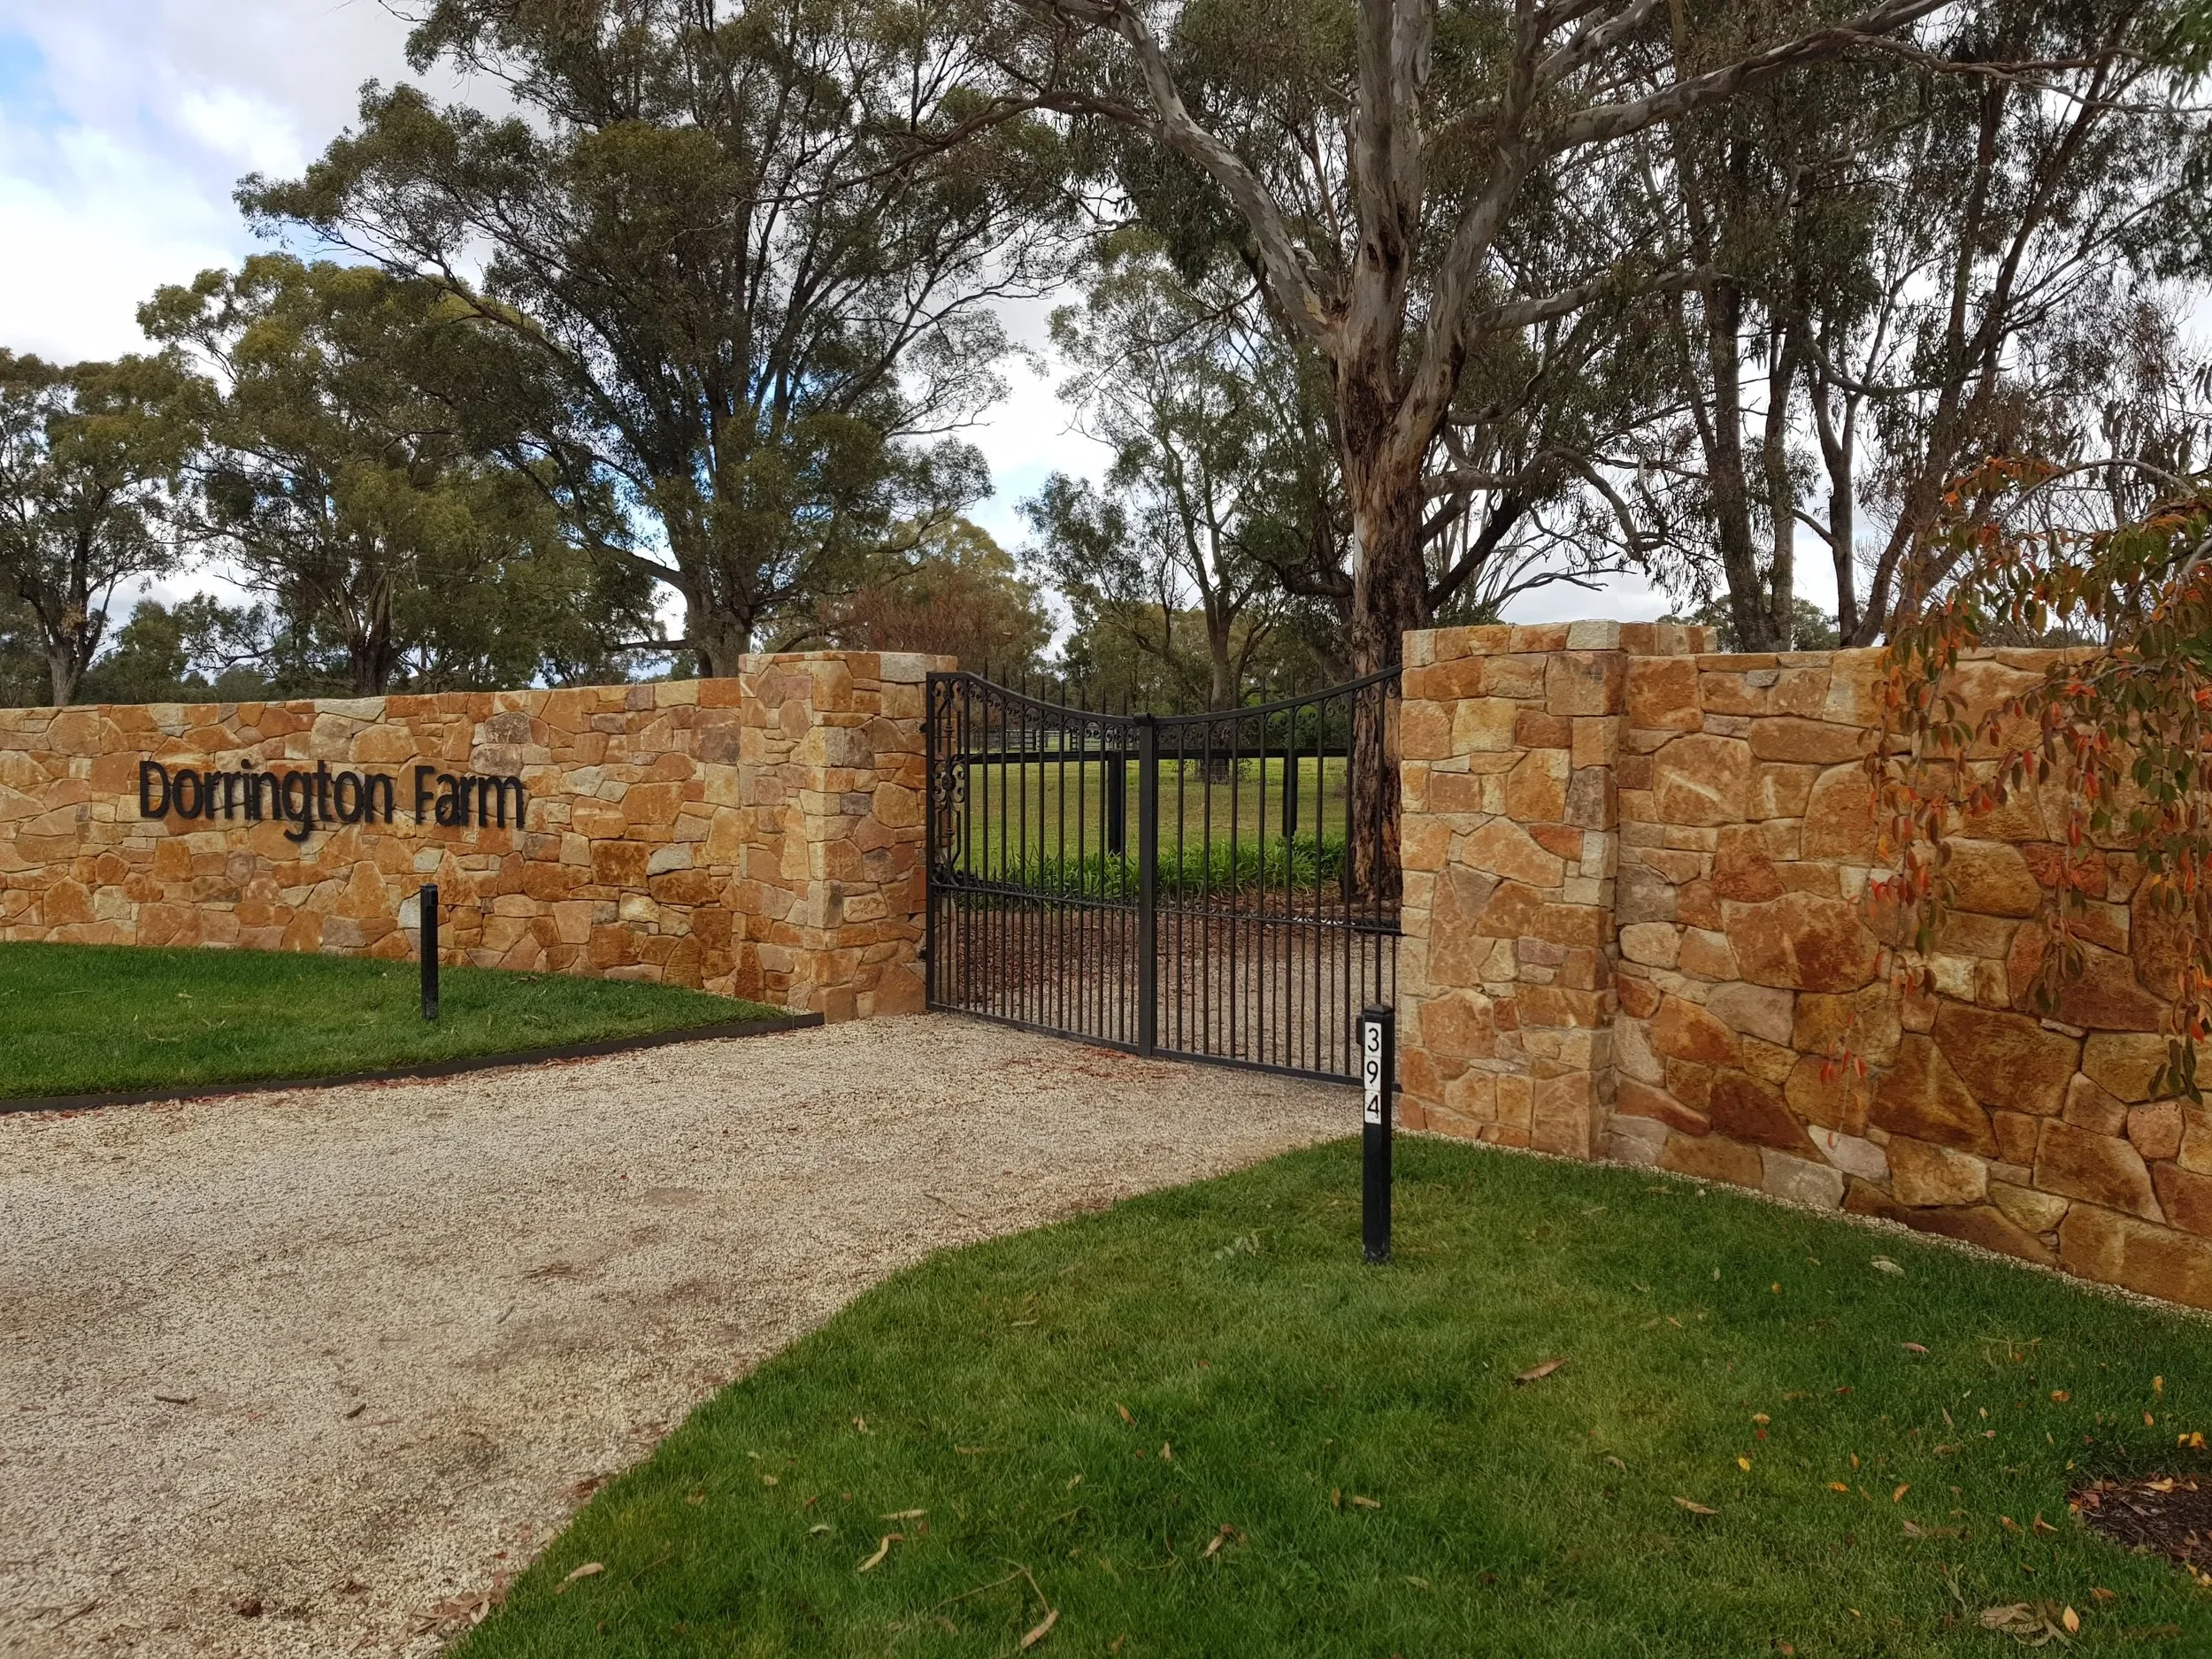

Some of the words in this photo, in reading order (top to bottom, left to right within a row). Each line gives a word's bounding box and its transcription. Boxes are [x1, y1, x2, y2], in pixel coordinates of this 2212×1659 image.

[139, 758, 394, 842] Dorrington
[415, 765, 525, 829] Farm
[1366, 1027, 1379, 1118] 394
